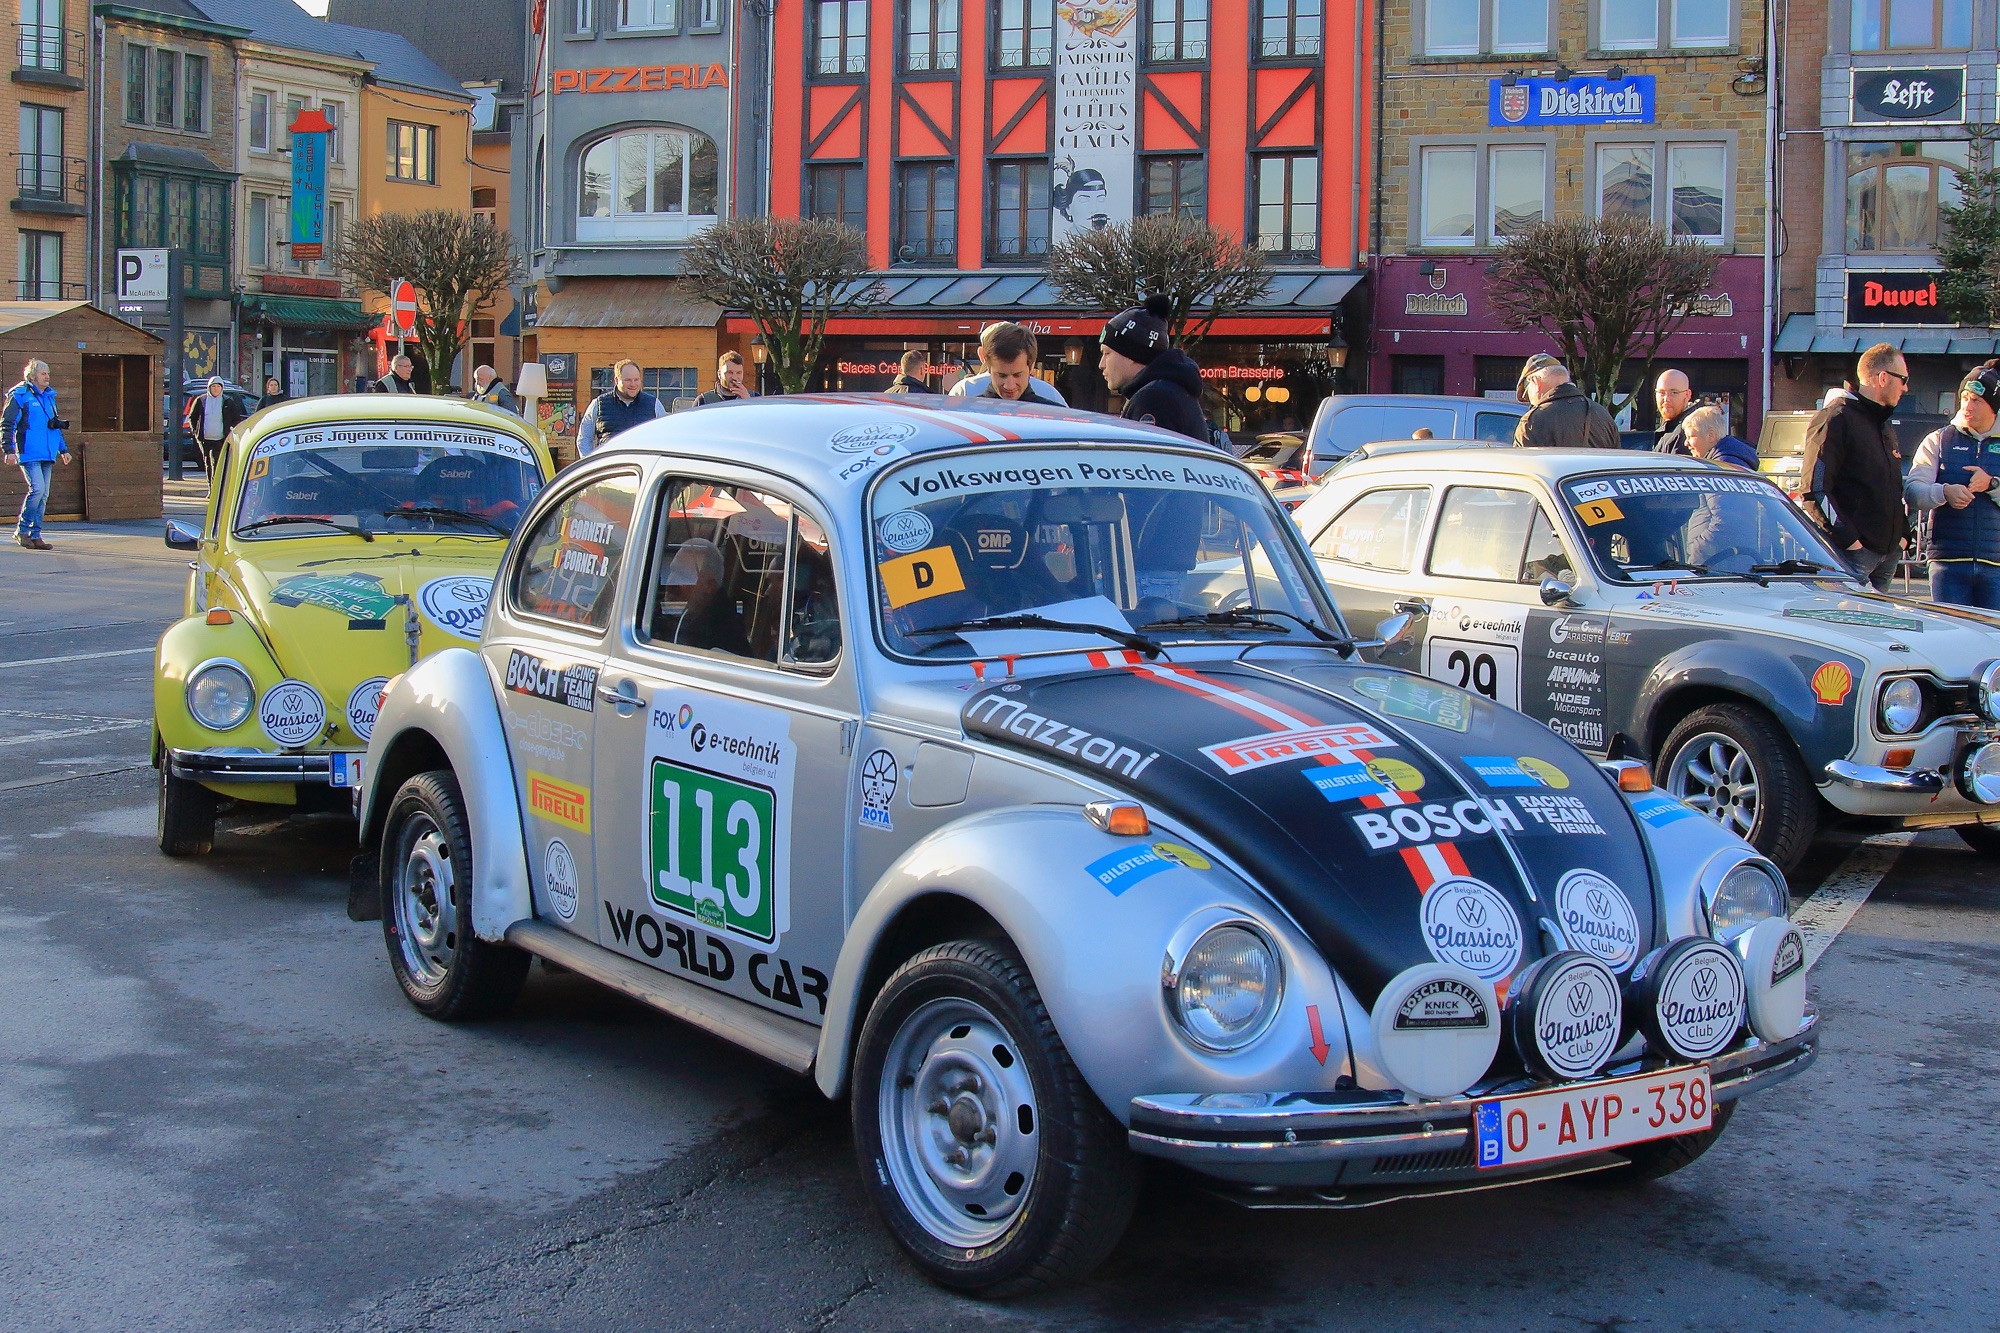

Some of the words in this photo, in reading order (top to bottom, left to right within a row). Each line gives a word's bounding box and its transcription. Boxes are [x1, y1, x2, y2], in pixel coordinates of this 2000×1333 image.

[553, 62, 729, 95] PIZZERIA
[1539, 83, 1643, 117] Diekirch
[1880, 79, 1935, 110] Leffe
[121, 255, 143, 296] P
[1863, 279, 1938, 307] Duvel
[1406, 293, 1467, 314] Diekirch
[1126, 319, 1137, 330] 10
[1148, 330, 1160, 341] 50
[840, 362, 876, 374] Glaces
[1228, 365, 1285, 379] Brasserie
[294, 432, 324, 445] Les
[327, 429, 390, 443] Joyeux
[394, 429, 496, 448] Condruziens
[831, 432, 908, 446] Classics
[257, 443, 277, 456] FOX
[498, 444, 519, 456] FOX
[255, 460, 266, 476] D
[438, 468, 473, 479] Sabelt
[838, 455, 877, 481] FOX
[899, 463, 1075, 498] Volkswagen
[1081, 462, 1176, 483] Porsche
[1182, 467, 1257, 498] Austria
[1615, 476, 1764, 496] GARAGELEYON.BE
[285, 490, 319, 501] Sabelt
[1578, 489, 1599, 499] FOX
[1591, 506, 1606, 519] D
[884, 526, 931, 545] Classics
[977, 533, 1012, 548] OMP
[911, 561, 934, 590] D
[1473, 618, 1522, 634] e-technik
[1547, 648, 1600, 664] becauto
[507, 653, 560, 698] BOSCH
[563, 664, 596, 681] RACING
[1447, 649, 1498, 701] 29
[563, 676, 594, 700] TEAM
[567, 694, 594, 712] VIENNA
[1547, 691, 1591, 706] ANDES
[1554, 701, 1602, 717] Motorsport
[263, 709, 322, 729] Classics
[653, 709, 677, 732] FOX
[282, 726, 304, 736] Club
[1548, 717, 1603, 742] Graffiti
[709, 732, 781, 766] e-technik
[1211, 726, 1384, 769] PIRELLI
[334, 772, 345, 784] B
[742, 761, 766, 777] belgien
[1474, 766, 1525, 776] BILSTEIN
[1315, 773, 1373, 790] BILSTEIN
[532, 778, 585, 825] PIRELLI
[1515, 795, 1585, 809] RACING
[863, 806, 890, 824] ROTA
[1524, 807, 1596, 823] TEAM
[1352, 799, 1524, 850] BOSCH
[1550, 822, 1607, 835] VIENNA
[658, 779, 762, 918] 113
[1099, 849, 1159, 885] BILSTEIN
[547, 873, 577, 900] Classics
[1453, 886, 1482, 895] Belgian
[1428, 923, 1516, 949] Classics
[1562, 910, 1635, 945] Classics
[1590, 938, 1615, 954] Club
[604, 900, 735, 982] WORLD
[748, 953, 829, 1016] CAR
[1460, 949, 1491, 963] Club
[1694, 956, 1719, 966] Belgian
[1568, 969, 1593, 982] Belgian
[1400, 982, 1440, 1016] BOSCH
[1443, 981, 1484, 1014] RALLYE
[1425, 1001, 1459, 1009] KNICK
[1661, 998, 1736, 1028] Classics
[1540, 1011, 1614, 1051] Classics
[1687, 1024, 1714, 1038] Club
[1567, 1039, 1594, 1058] Club
[1483, 1139, 1499, 1161] B
